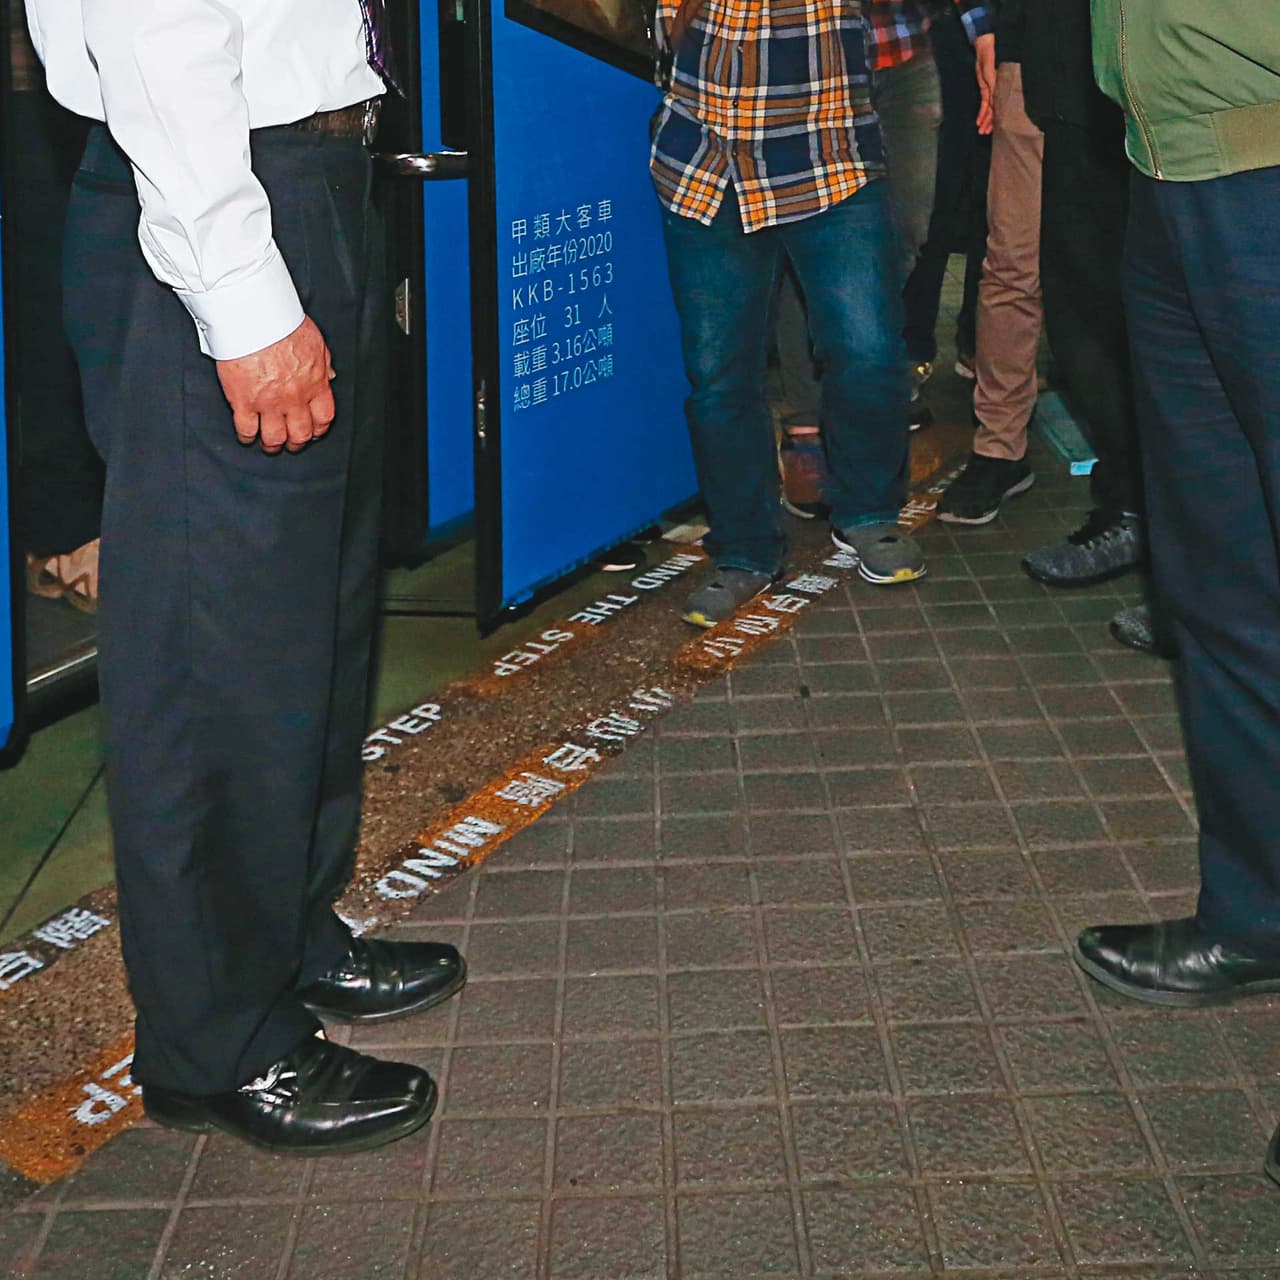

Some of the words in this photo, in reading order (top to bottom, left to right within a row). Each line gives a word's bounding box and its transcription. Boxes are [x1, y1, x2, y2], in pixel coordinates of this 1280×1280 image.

[511, 199, 613, 244] 甲類大客車
[512, 231, 613, 278] 出廠年份2020
[512, 262, 614, 311] KKB-1563
[512, 314, 547, 346] 座位
[563, 304, 581, 328] 31
[598, 292, 613, 319] 人
[513, 345, 547, 379] 載重
[551, 323, 613, 365] 3.16公噸
[513, 377, 547, 412] 總重
[552, 354, 613, 397] 17.0公噸
[568, 594, 639, 625] THE
[494, 629, 574, 676] STEP
[362, 703, 442, 761] STEP
[375, 815, 505, 900] MIND
